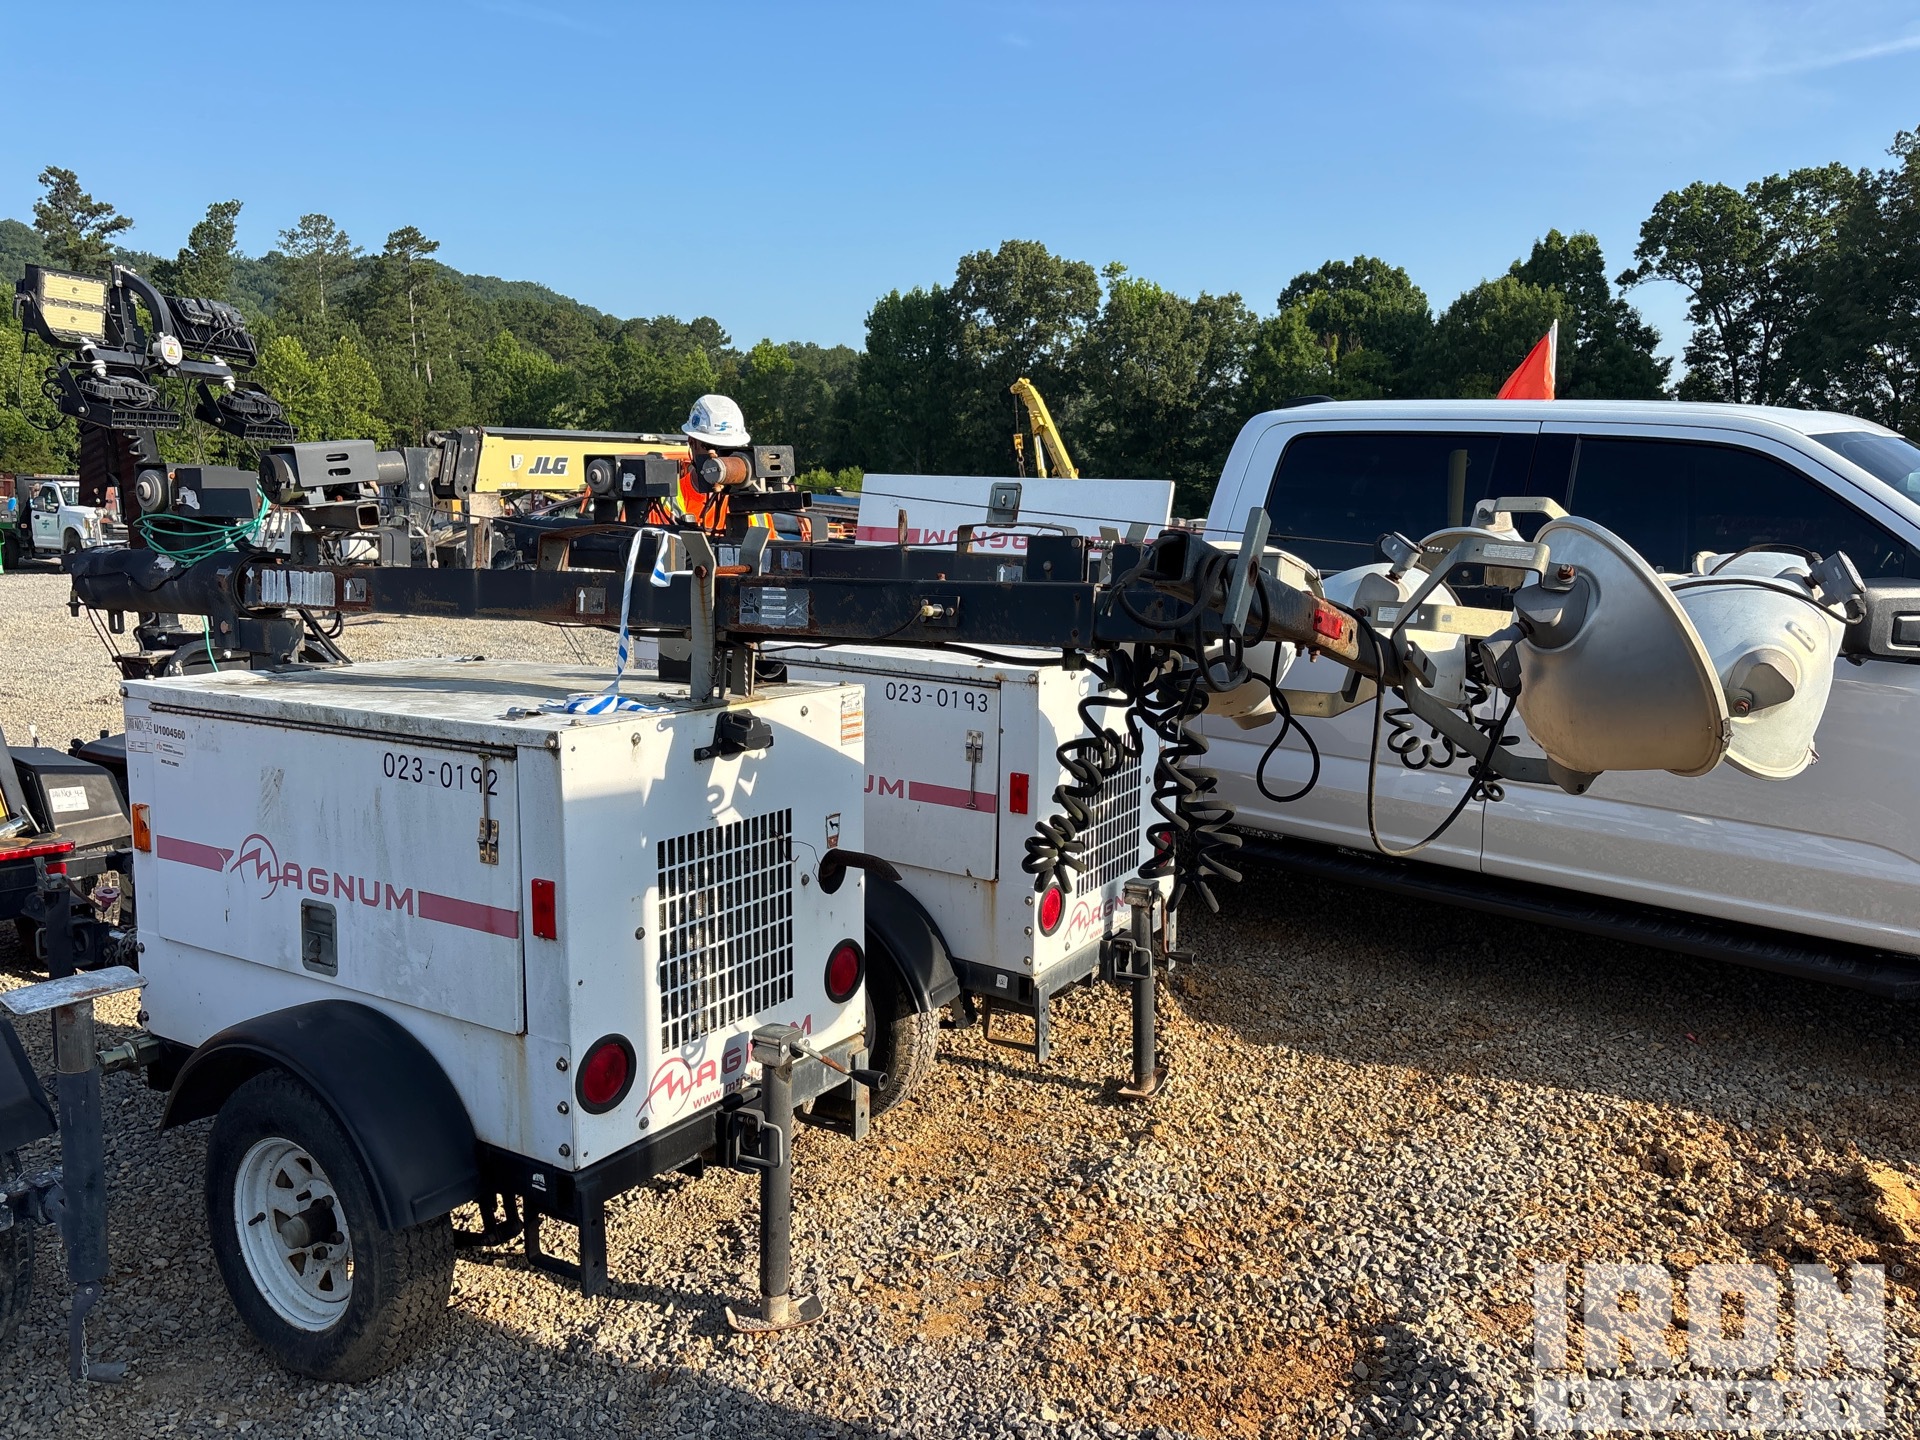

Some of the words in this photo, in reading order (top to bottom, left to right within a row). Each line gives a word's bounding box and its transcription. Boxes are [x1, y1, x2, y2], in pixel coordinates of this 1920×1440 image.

[528, 456, 569, 475] JLG
[885, 682, 988, 713] 023-0193
[153, 723, 186, 741] U1004560
[383, 752, 498, 796] 023-0192
[230, 834, 414, 916] MAGNUM
